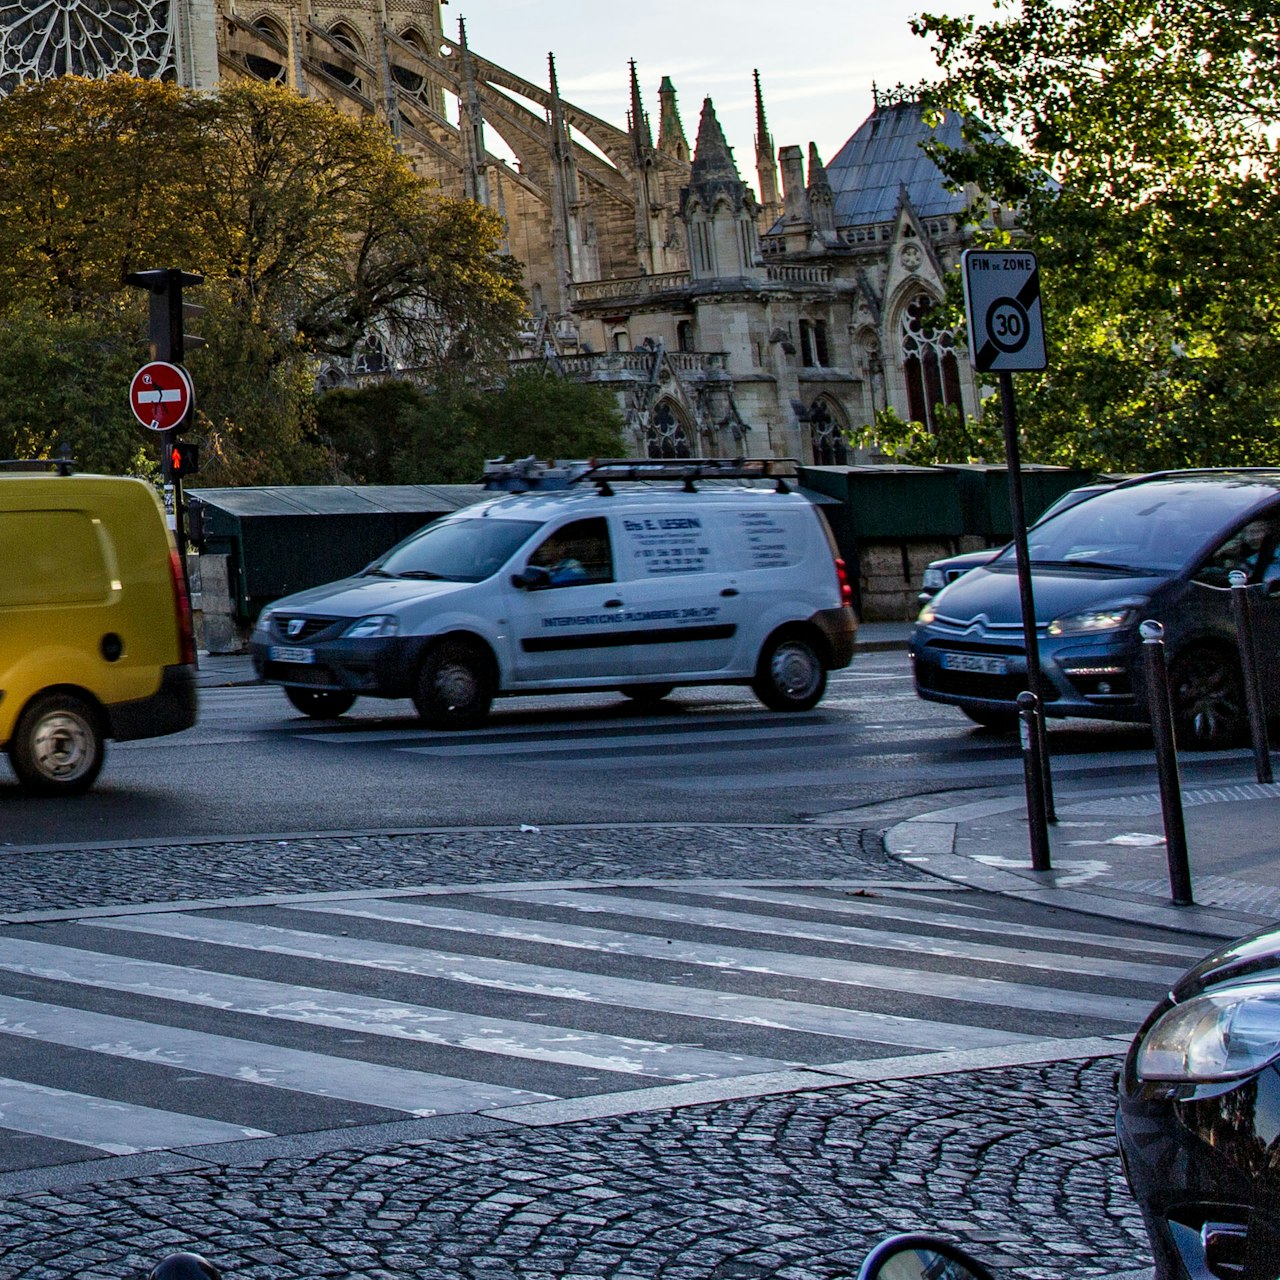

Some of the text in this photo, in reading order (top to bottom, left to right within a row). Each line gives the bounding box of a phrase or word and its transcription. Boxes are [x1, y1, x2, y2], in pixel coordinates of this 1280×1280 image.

[972, 259, 989, 270] FIN
[1002, 259, 1033, 270] ZONE
[996, 314, 1020, 336] 30
